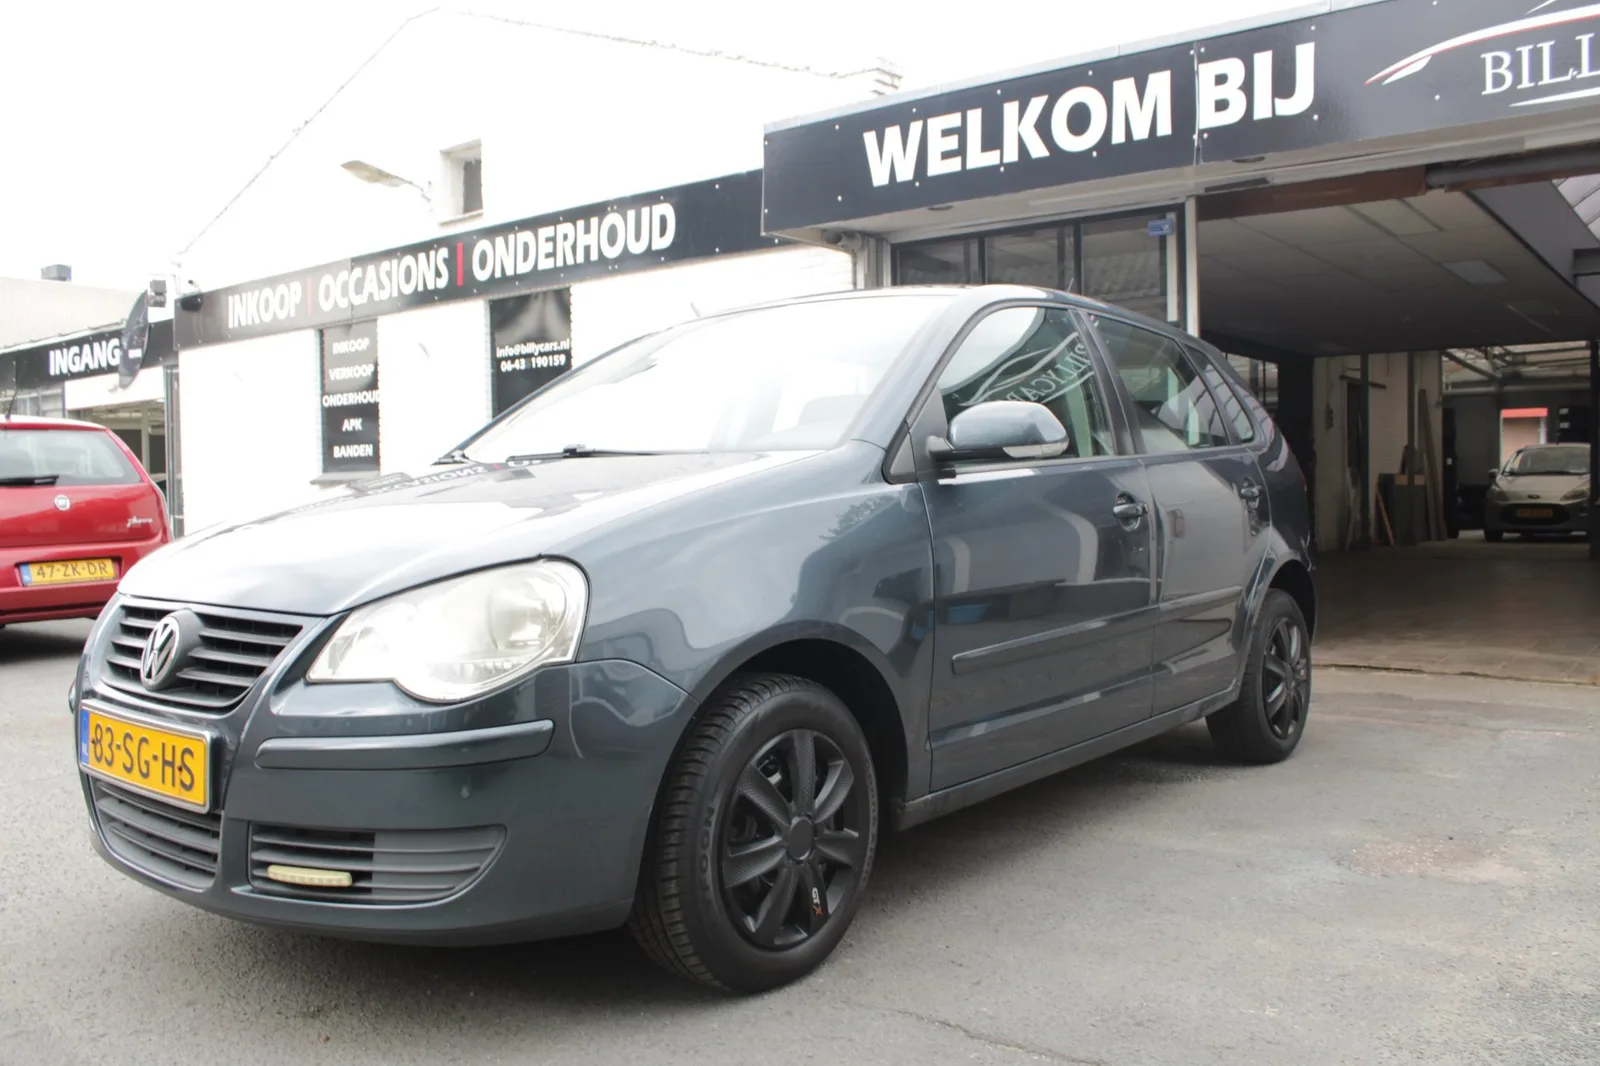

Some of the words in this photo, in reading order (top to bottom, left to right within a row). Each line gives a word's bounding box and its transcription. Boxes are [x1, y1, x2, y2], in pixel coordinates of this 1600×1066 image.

[862, 69, 1173, 188] WELKOM
[1199, 41, 1316, 130] BIJ
[227, 281, 302, 329] INKOOP
[318, 246, 450, 312] OCCASIONS
[472, 202, 676, 282] ONDERHOUD
[332, 337, 370, 355] INKOOP
[48, 338, 120, 376] INGANG
[328, 363, 375, 381] VERKOOP
[342, 418, 363, 432] APK
[333, 444, 374, 458] BANDEN
[36, 561, 109, 579] 47-ZK-DR
[93, 722, 196, 792] 83-SG-HS
